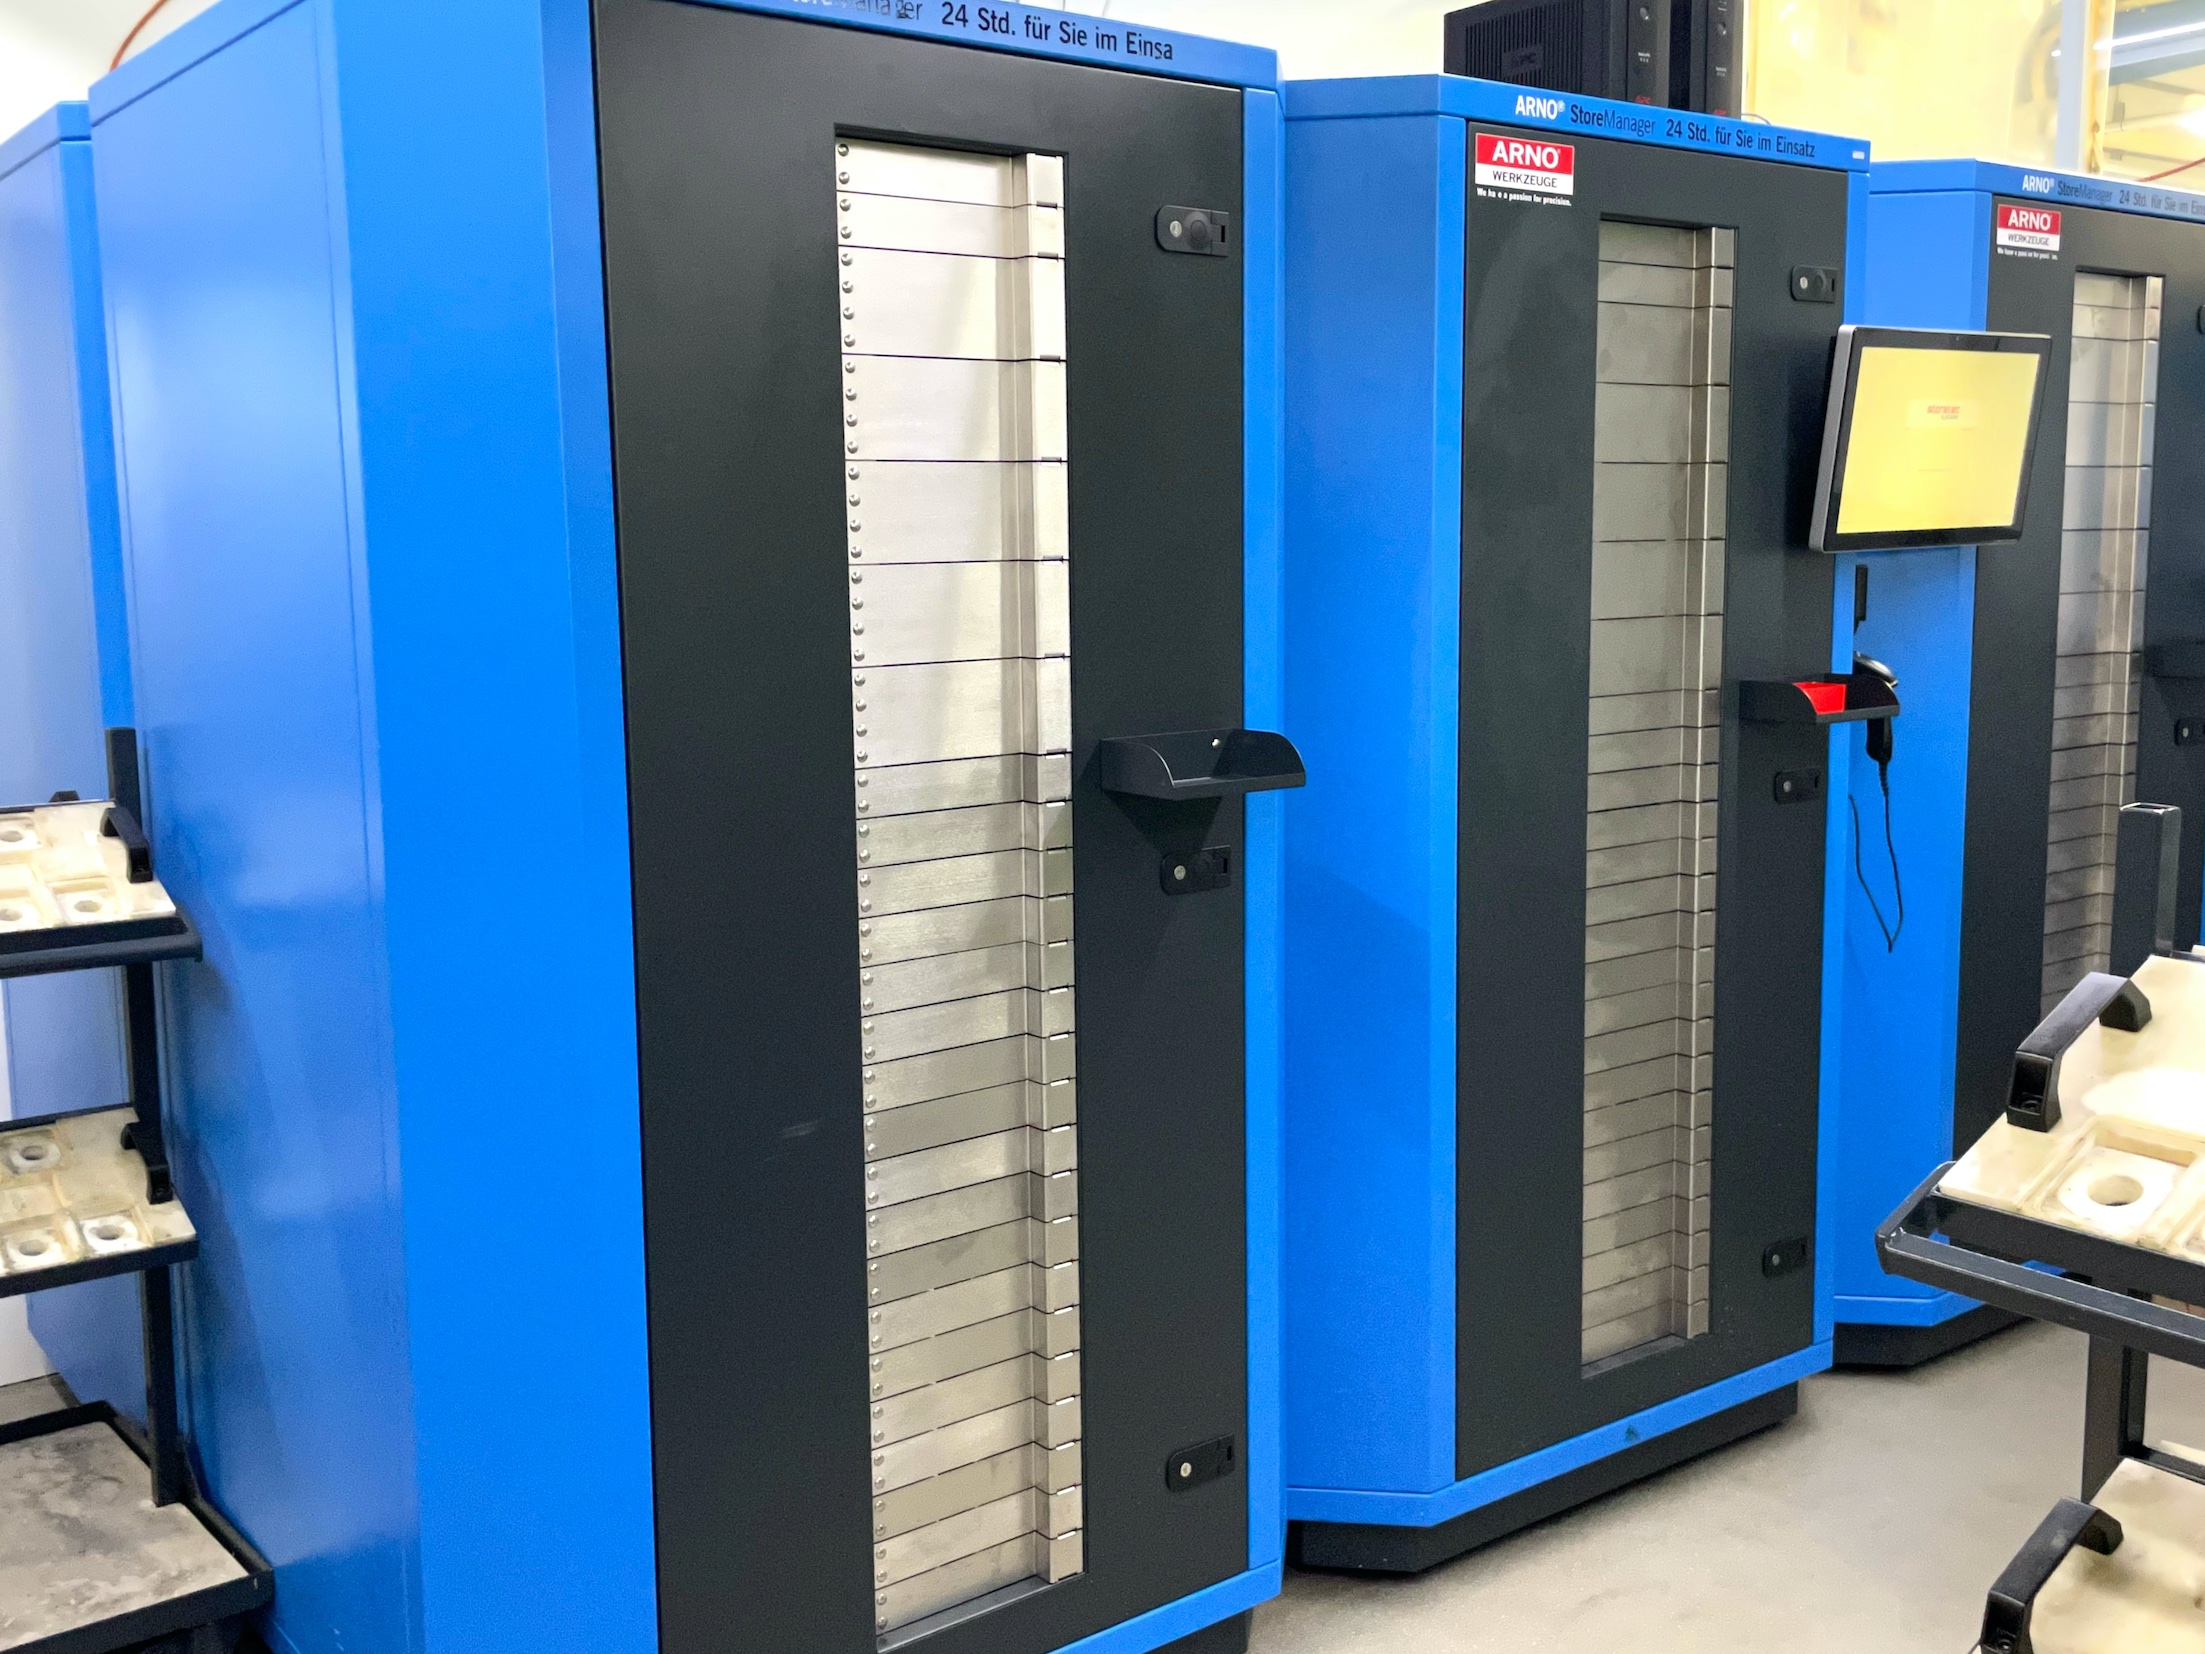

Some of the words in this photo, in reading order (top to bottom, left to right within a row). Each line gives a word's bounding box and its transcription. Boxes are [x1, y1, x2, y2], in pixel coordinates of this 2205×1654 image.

[941, 2, 968, 28] 24
[978, 7, 1016, 35] Std.
[1024, 14, 1051, 41] für
[1059, 21, 1088, 47] Sie
[1095, 27, 1117, 52] im
[1570, 104, 1656, 137] StoreManager
[1666, 119, 1683, 138] 24
[1687, 123, 1710, 143] Std.
[1715, 126, 1731, 146] für
[1736, 129, 1753, 149] Sie
[1757, 132, 1771, 151] im
[1776, 135, 1815, 158] Einsatz
[1492, 170, 1558, 188] WERKZEUGE
[1488, 189, 1502, 198] hae
[1508, 192, 1532, 201] passion
[2057, 181, 2113, 206] StoreManager
[2119, 190, 2130, 203] 24
[2134, 191, 2147, 206] Std.
[2151, 193, 2162, 208] für
[2165, 196, 2177, 211] Sie
[2008, 233, 2050, 246] WERKZEUGE
